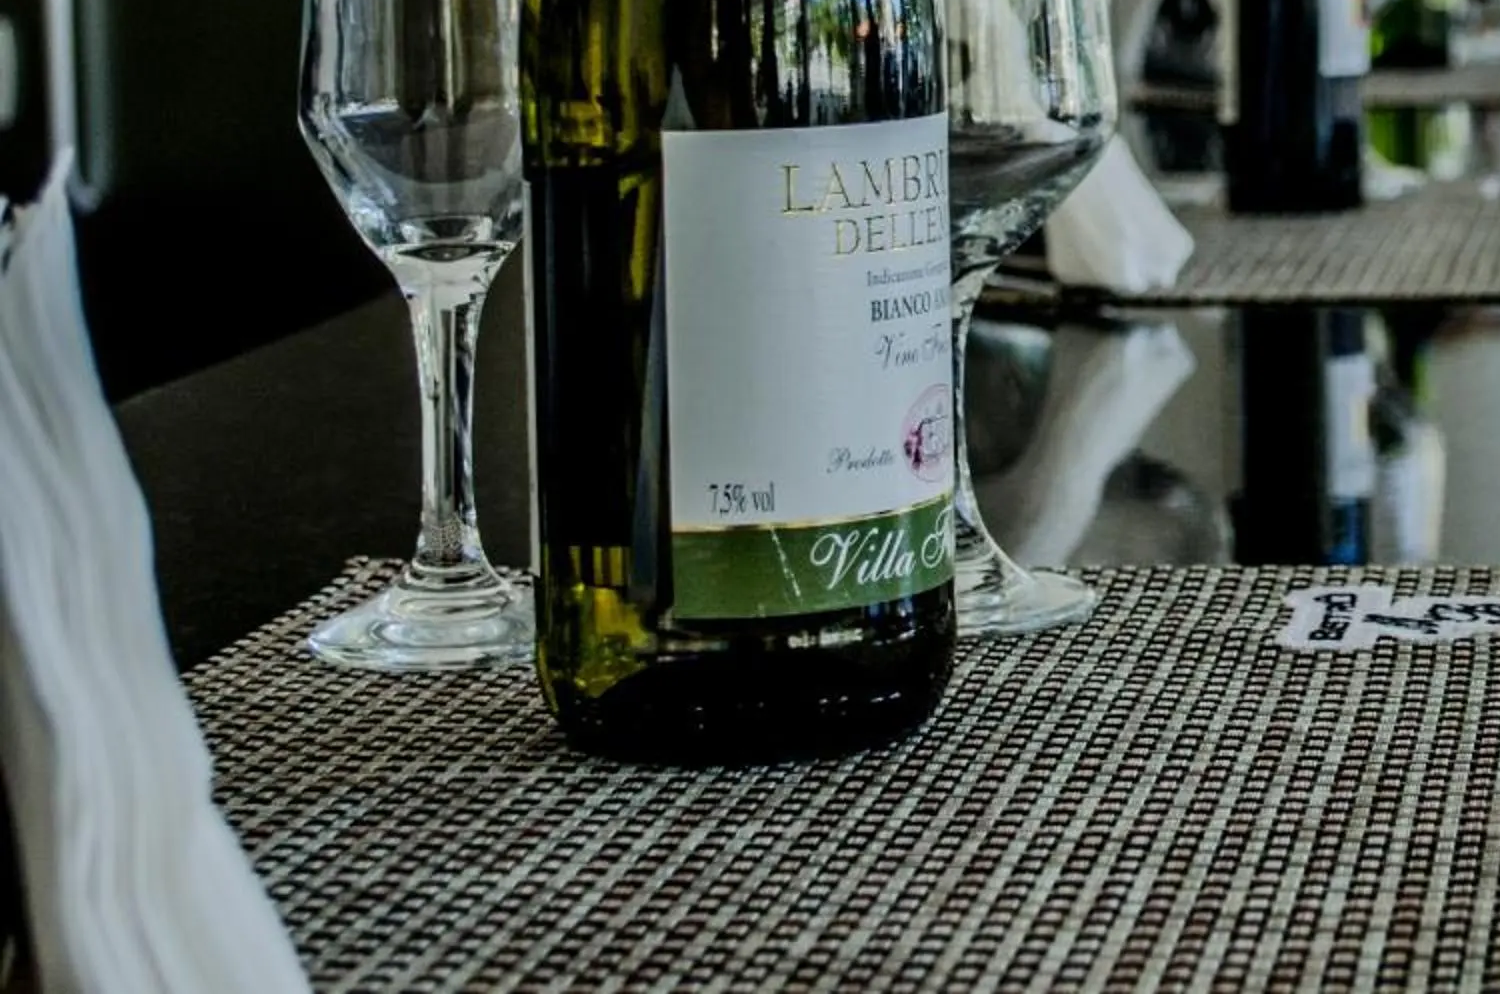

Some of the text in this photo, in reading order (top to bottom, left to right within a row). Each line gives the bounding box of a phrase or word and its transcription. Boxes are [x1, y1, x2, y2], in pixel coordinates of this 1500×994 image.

[870, 291, 931, 322] BIANCO
[751, 480, 776, 512] vol
[809, 525, 915, 591] Villa
